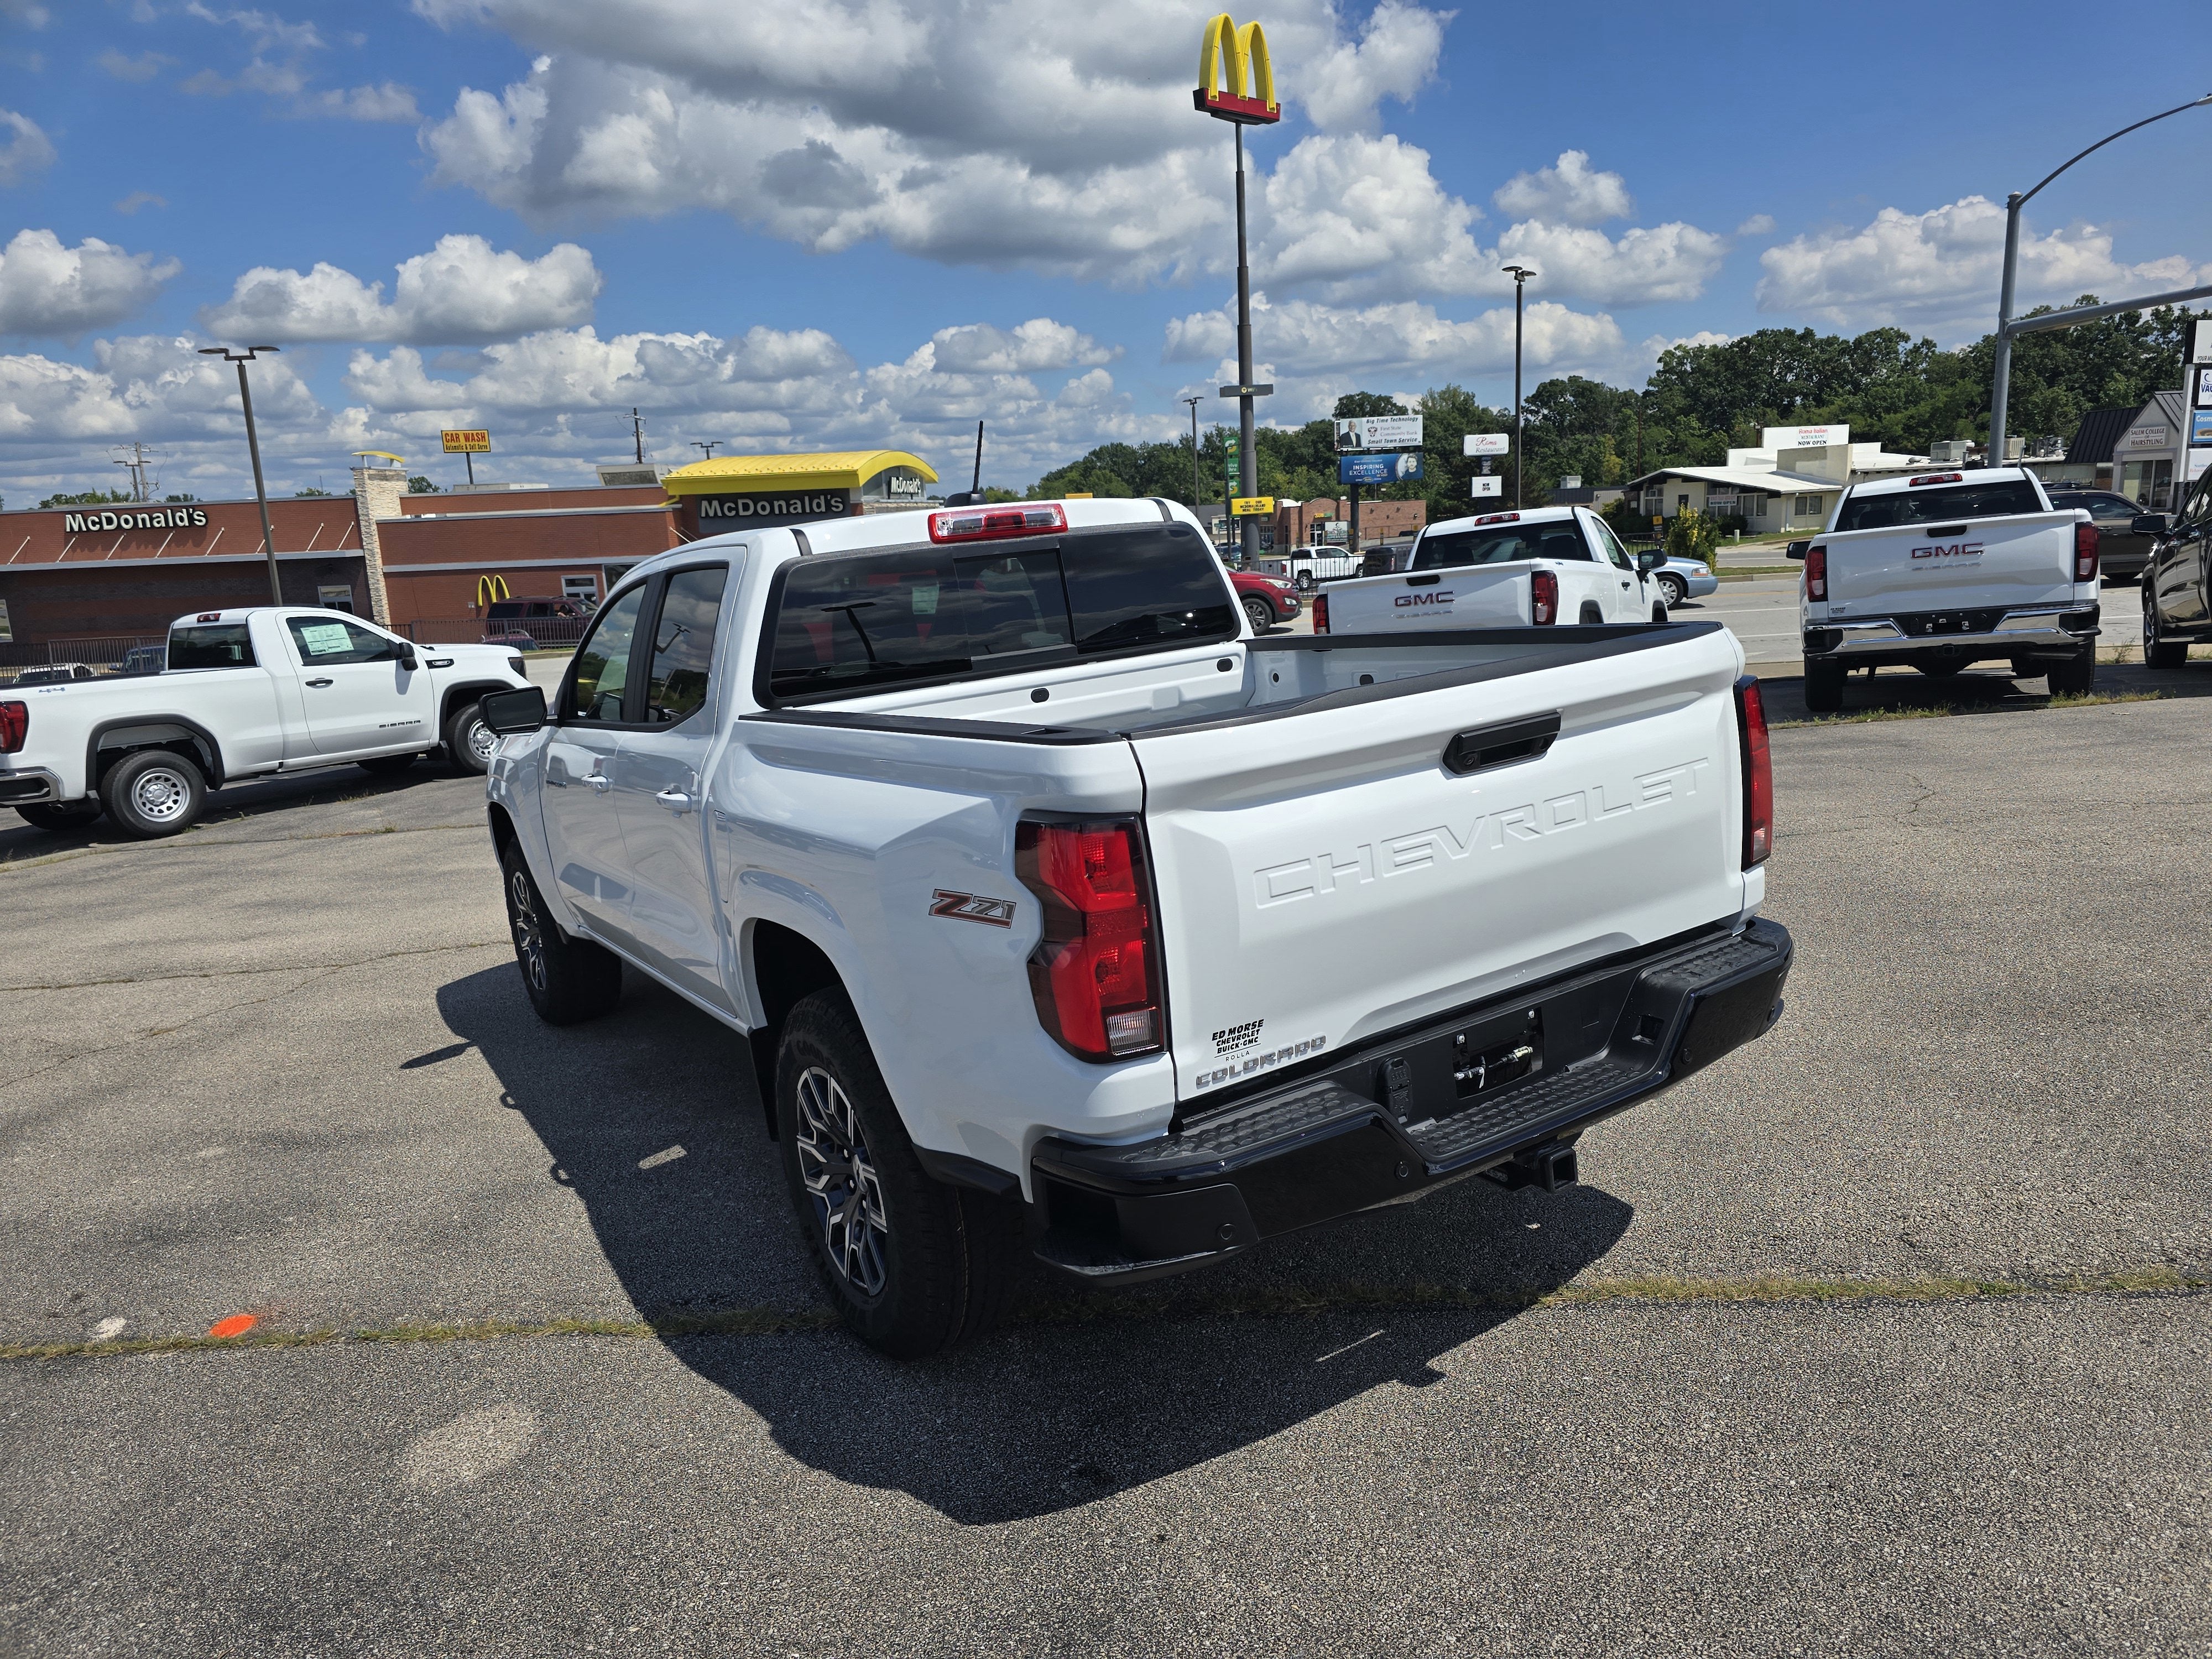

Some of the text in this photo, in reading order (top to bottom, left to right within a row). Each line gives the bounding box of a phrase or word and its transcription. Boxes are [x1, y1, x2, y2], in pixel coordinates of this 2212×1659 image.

[445, 432, 486, 443] CAR WASH
[890, 477, 921, 493] McDonald's
[701, 495, 843, 517] McDonald's
[66, 508, 206, 532] McDonald's
[1911, 541, 1985, 559] GMC
[1395, 591, 1455, 607] GMC
[1253, 757, 1709, 909] CHEVROLET
[928, 889, 1016, 929] Z71
[1212, 1019, 1264, 1041] ED MORSE
[1217, 1029, 1260, 1046] CHEVROLET
[1196, 1035, 1326, 1087] COLORADO
[1225, 1050, 1250, 1062] ROLLA
